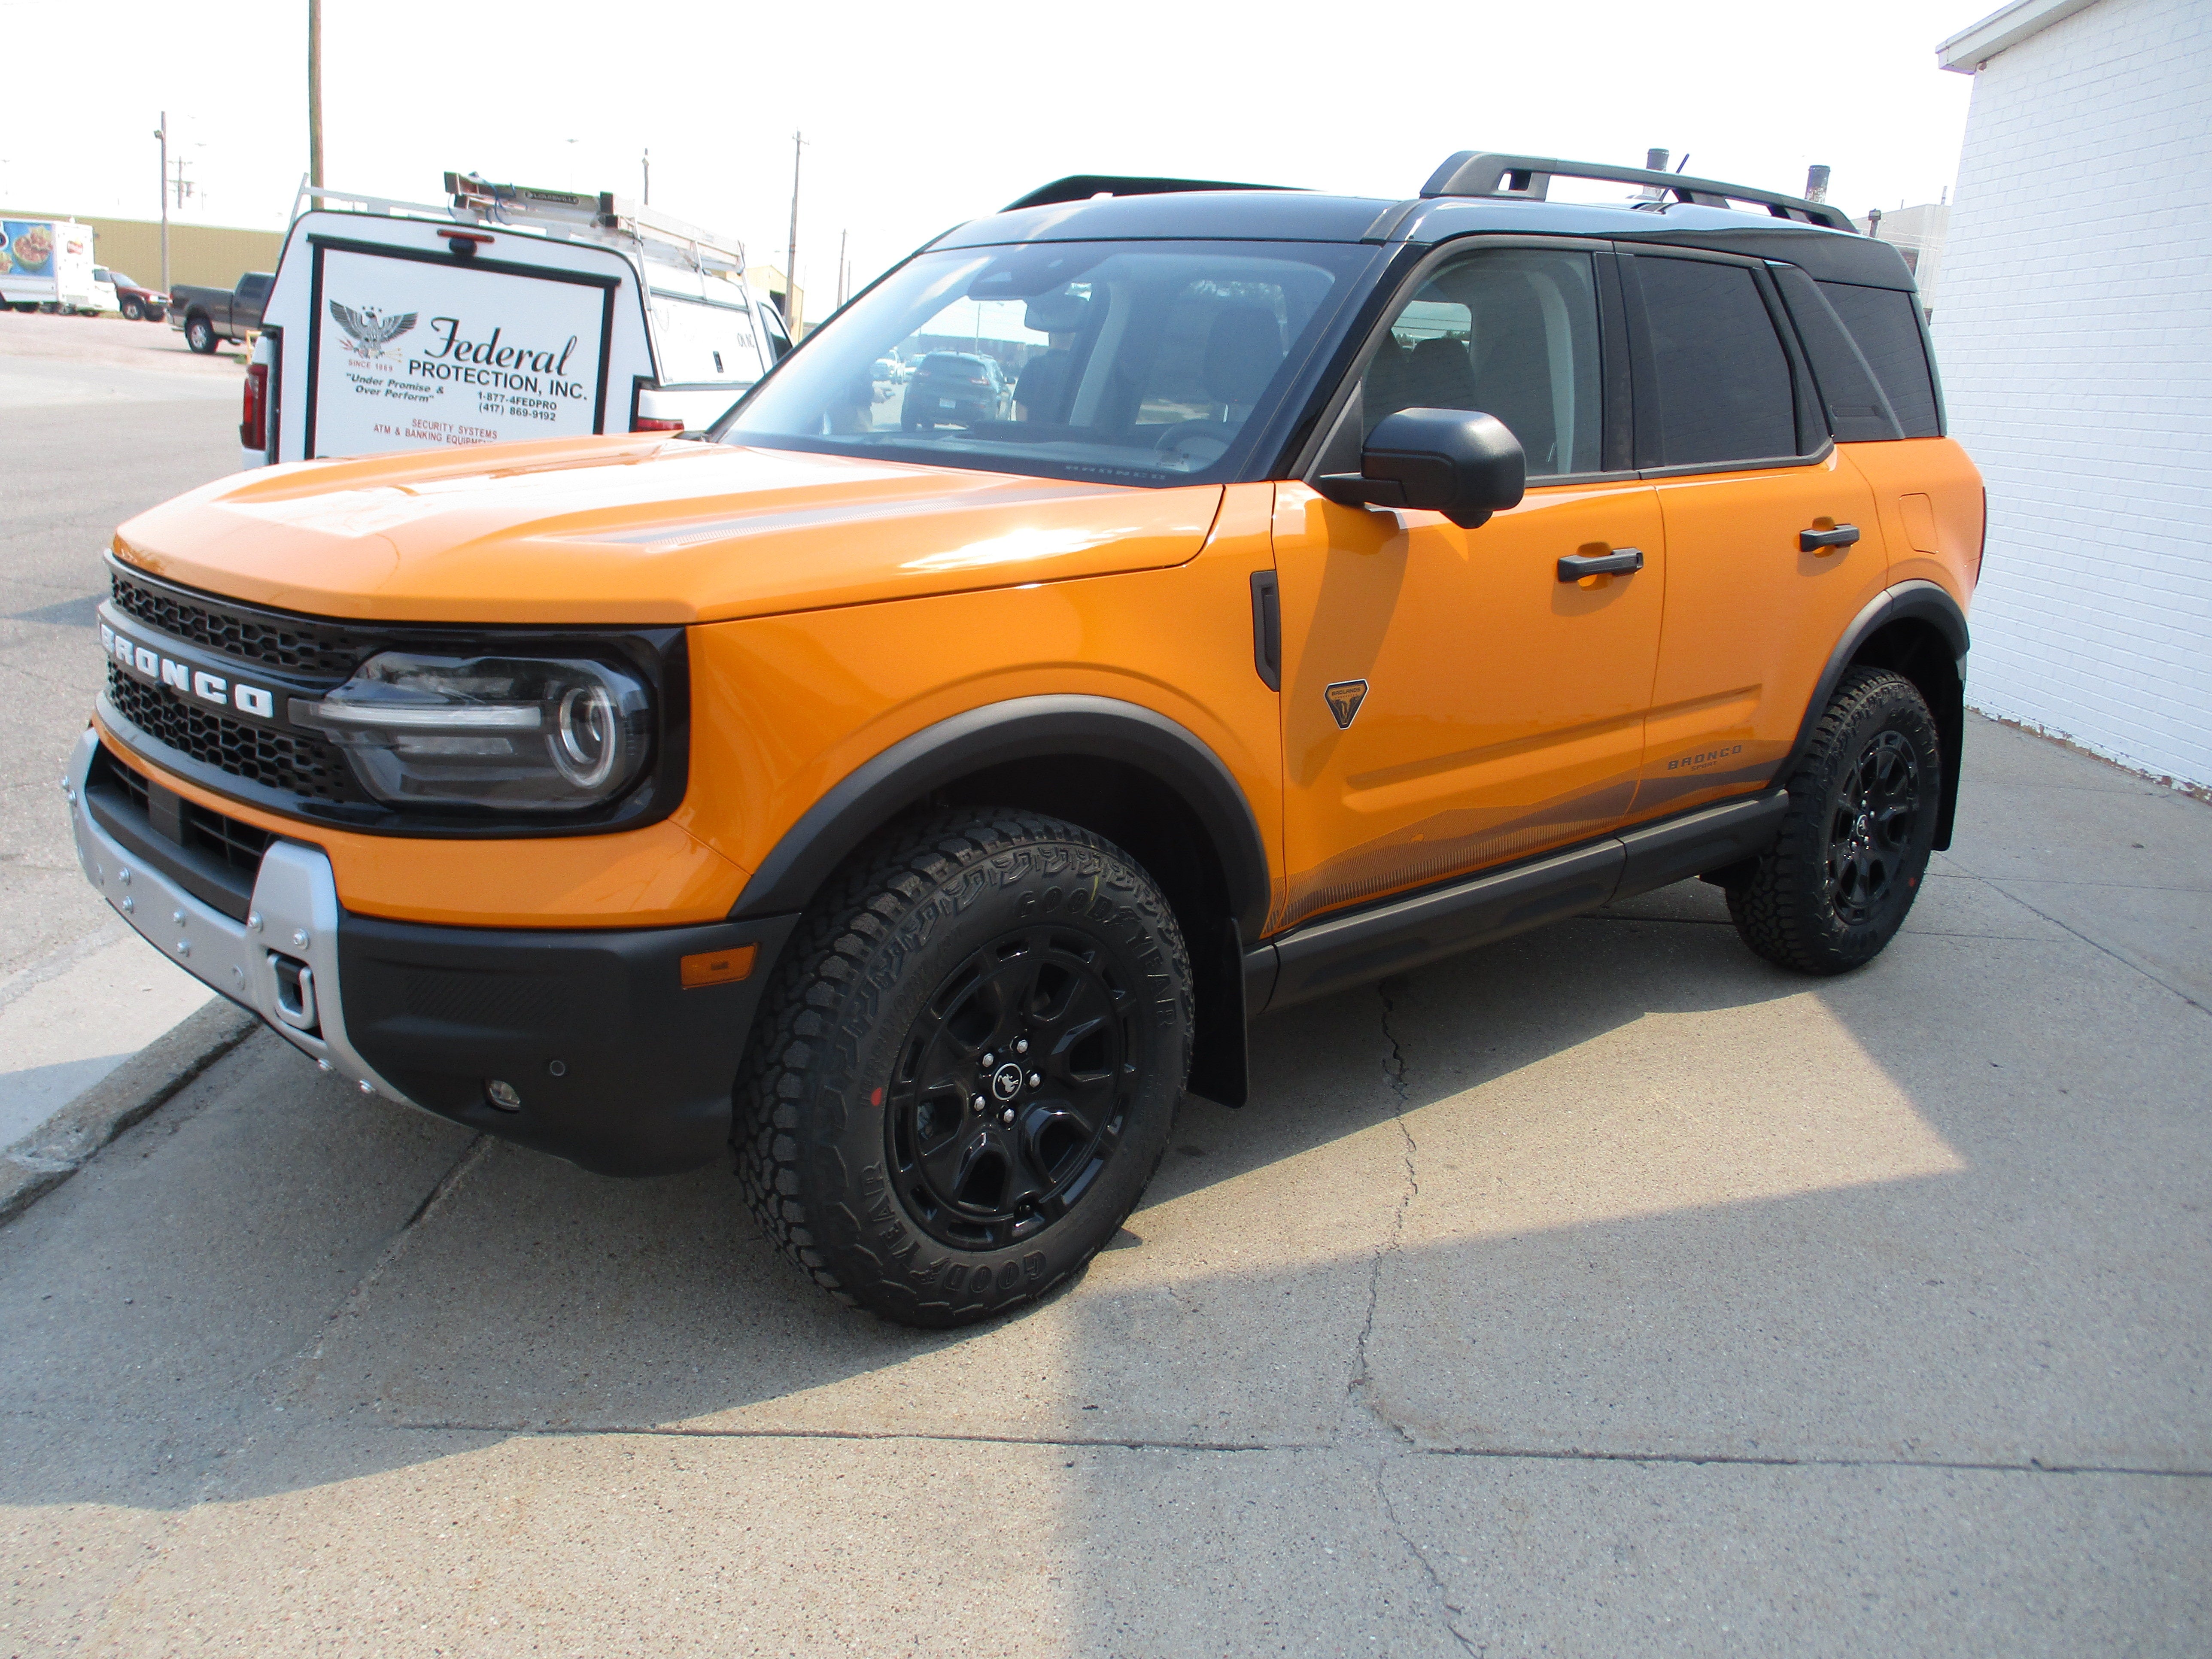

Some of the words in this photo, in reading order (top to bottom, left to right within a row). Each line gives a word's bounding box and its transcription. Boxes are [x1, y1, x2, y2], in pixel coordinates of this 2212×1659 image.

[424, 316, 577, 376] Federal
[349, 359, 371, 368] SINCE
[346, 373, 384, 386] "Under
[388, 379, 431, 392] Promise
[436, 386, 445, 394] &
[409, 359, 542, 397] PROTECTION,
[549, 380, 588, 401] INC.
[356, 385, 381, 395] Over
[385, 388, 434, 402] Perform"
[477, 391, 557, 410] 1-877-4FEDPRO
[479, 402, 504, 415] (417)
[510, 406, 556, 421] 869-9192
[374, 423, 391, 434] ATM
[395, 427, 401, 436] &
[405, 428, 443, 442] BANKING
[412, 418, 454, 433] SECURITY
[459, 425, 498, 439] SYSTEMS
[100, 622, 274, 719] BRONCO
[1331, 687, 1361, 696] BADLANDS
[1668, 744, 1742, 771] BRONCO
[1691, 760, 1718, 771] SPORT
[1016, 885, 1177, 1028] GOODYEAR
[862, 1161, 1047, 1294] GOODYEAR
